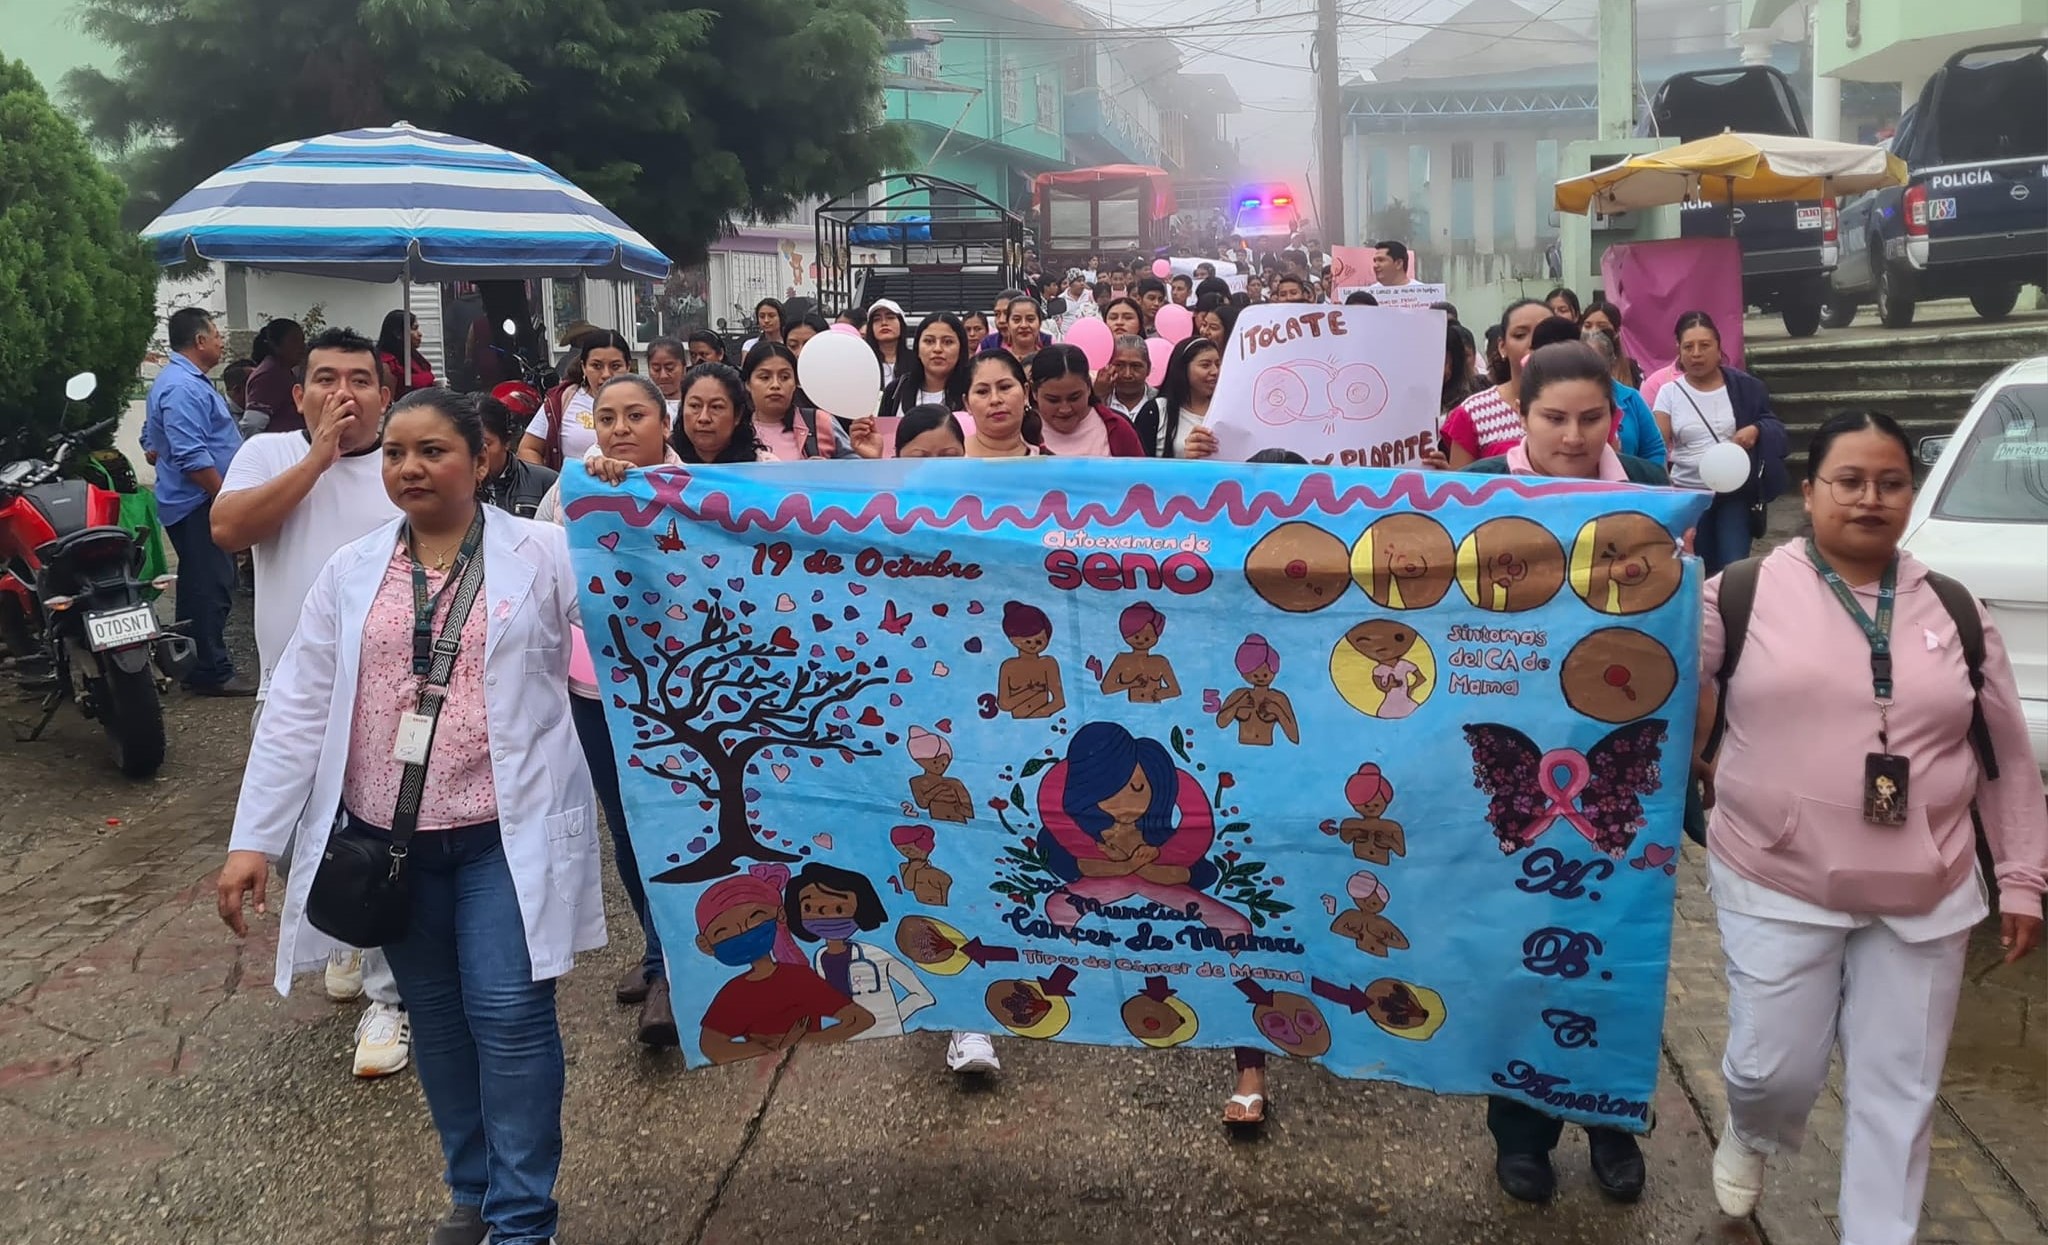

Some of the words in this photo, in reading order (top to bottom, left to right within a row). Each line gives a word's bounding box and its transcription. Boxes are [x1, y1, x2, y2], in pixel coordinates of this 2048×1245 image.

[1932, 167, 1993, 189] POLICÍA
[1929, 199, 1956, 220] 089
[752, 541, 793, 576] 19
[803, 549, 845, 575] de
[855, 546, 984, 580] Octubre
[95, 613, 150, 639] 07DSN7
[1085, 654, 1103, 681] 4
[1521, 651, 1552, 671] de
[1448, 671, 1519, 696] Mama
[977, 693, 999, 719] 3
[1202, 688, 1222, 713] 5
[900, 801, 919, 818] 2
[1065, 894, 1203, 922] Mundial
[1125, 922, 1174, 951] de
[1175, 925, 1305, 955] Mama
[1022, 949, 1080, 966] Tipos
[1081, 955, 1112, 969] de
[1196, 961, 1226, 977] de
[1229, 962, 1304, 983] Mama
